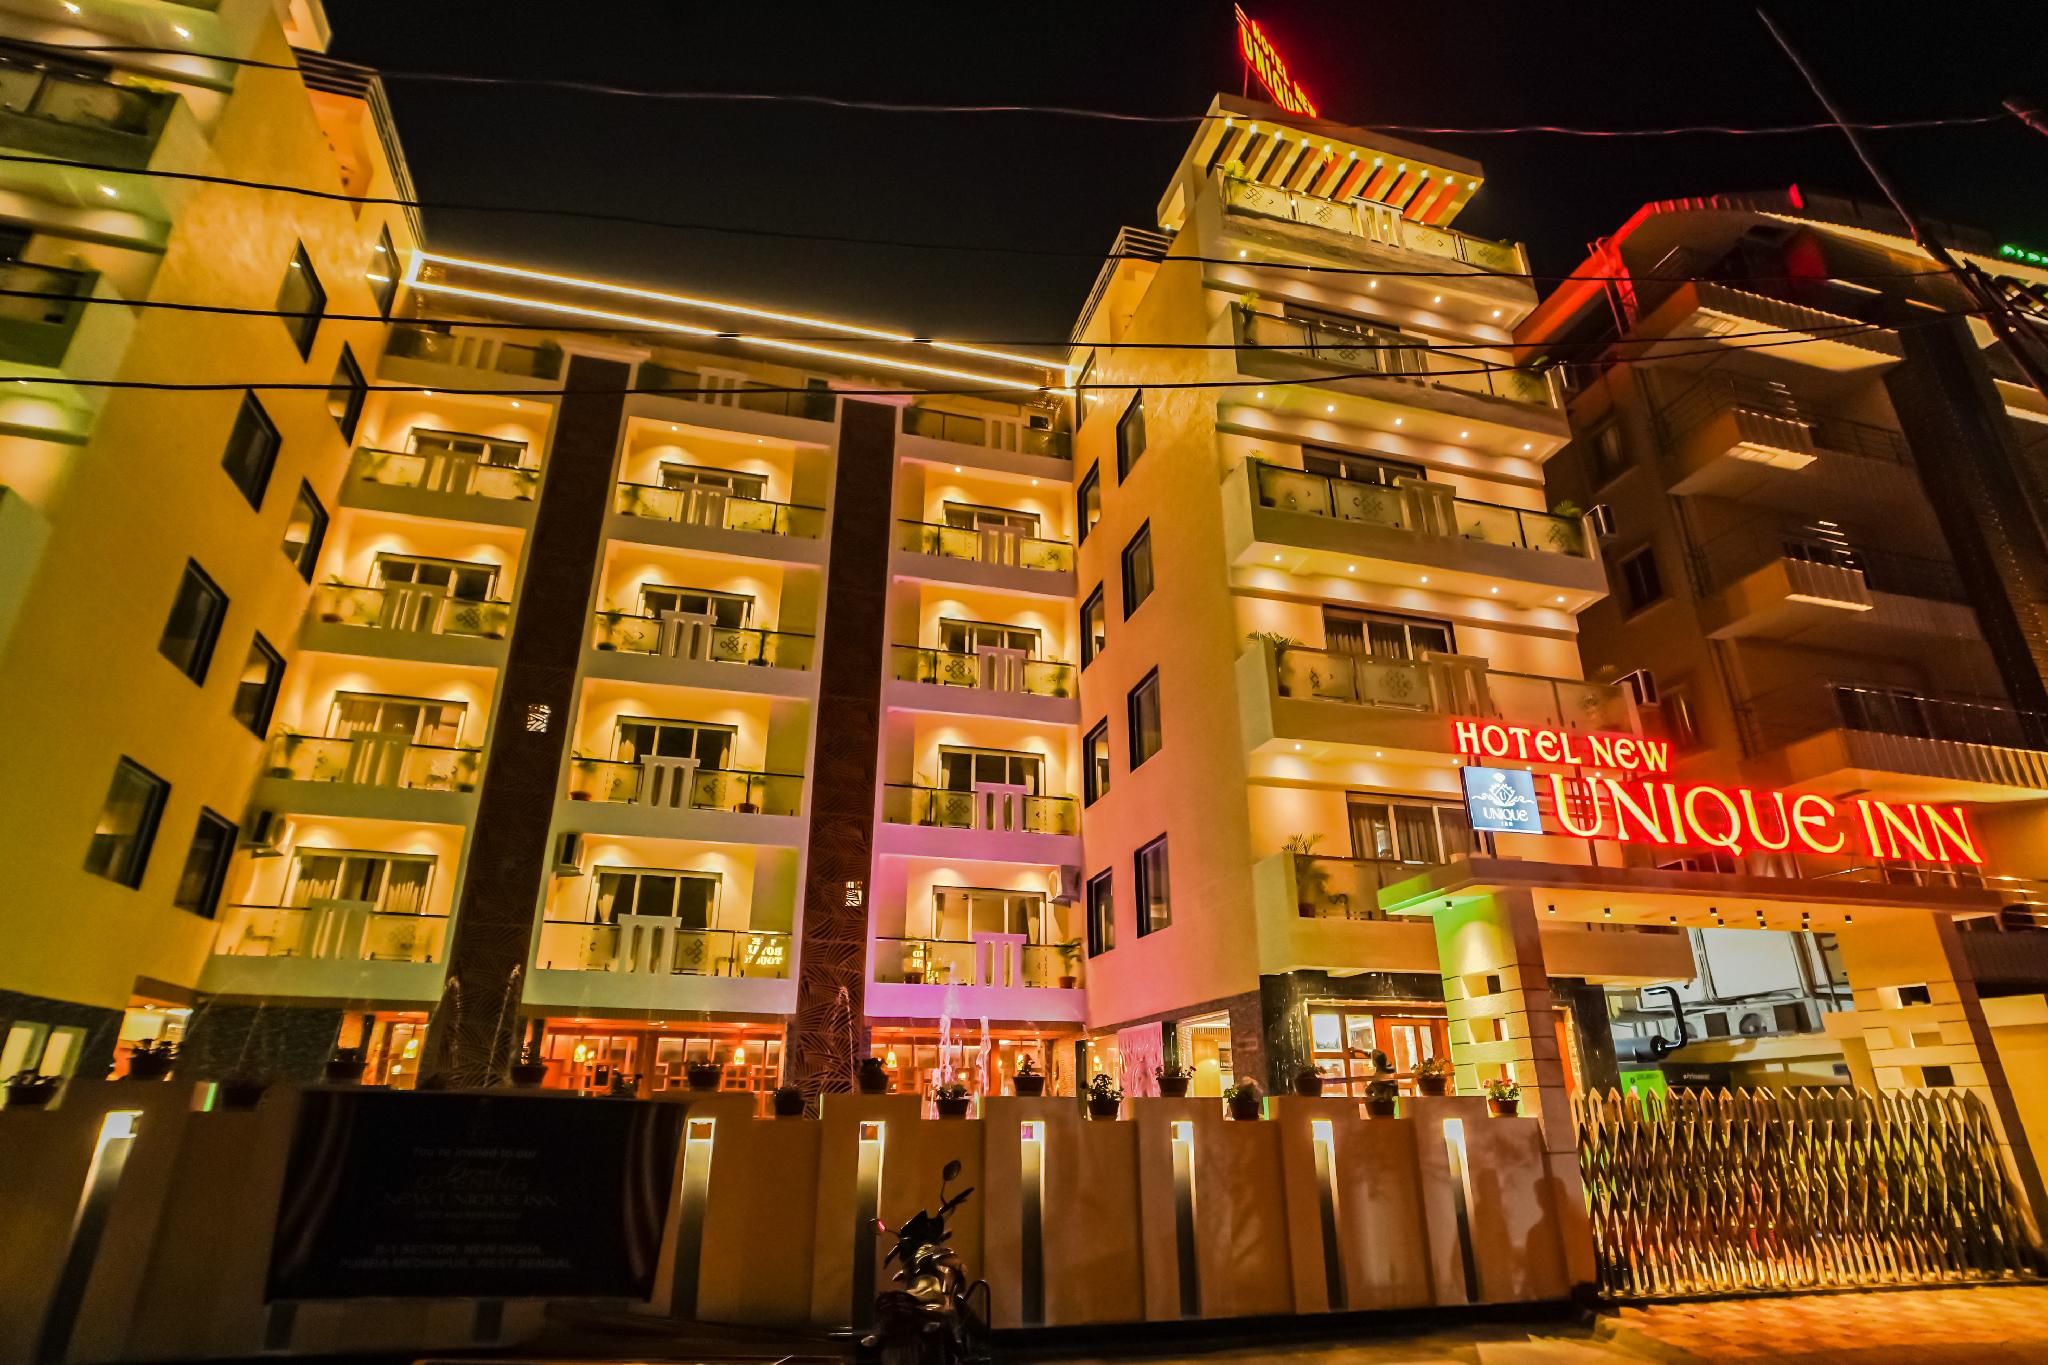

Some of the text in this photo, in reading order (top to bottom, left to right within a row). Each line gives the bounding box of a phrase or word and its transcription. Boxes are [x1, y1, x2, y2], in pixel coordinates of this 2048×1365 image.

[1251, 19, 1291, 87] HOTEL
[1455, 721, 1671, 773] HOTEL NEW
[1482, 806, 1529, 822] UNIQUE
[1550, 773, 1983, 864] UNIQUE INN
